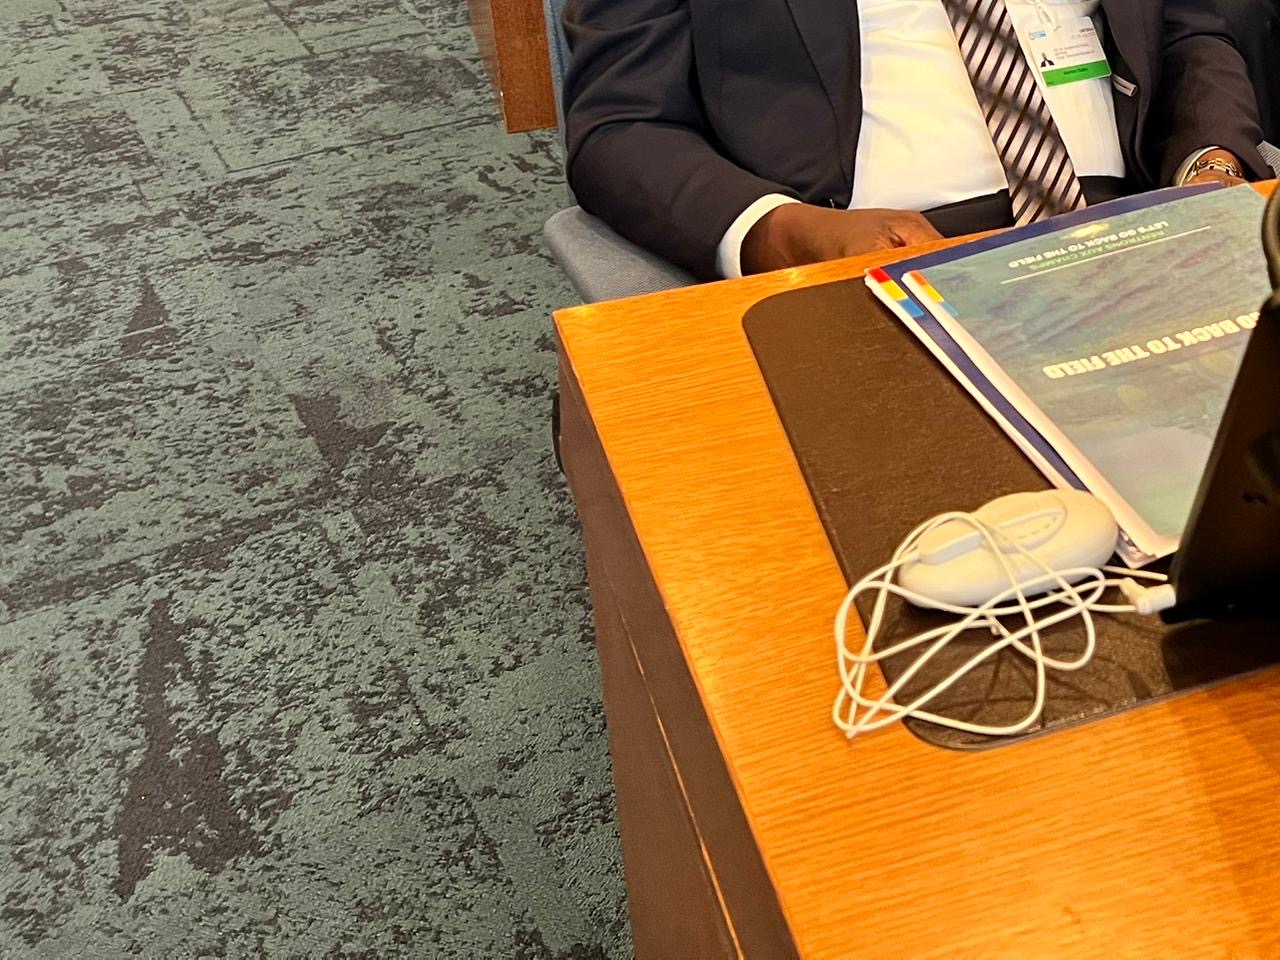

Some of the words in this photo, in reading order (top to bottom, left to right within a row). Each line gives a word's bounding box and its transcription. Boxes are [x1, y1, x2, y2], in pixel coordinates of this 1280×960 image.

[1146, 335, 1182, 354] TO
[1175, 319, 1240, 347] BACK
[1101, 344, 1150, 366] THE
[1042, 355, 1106, 379] FIELD
